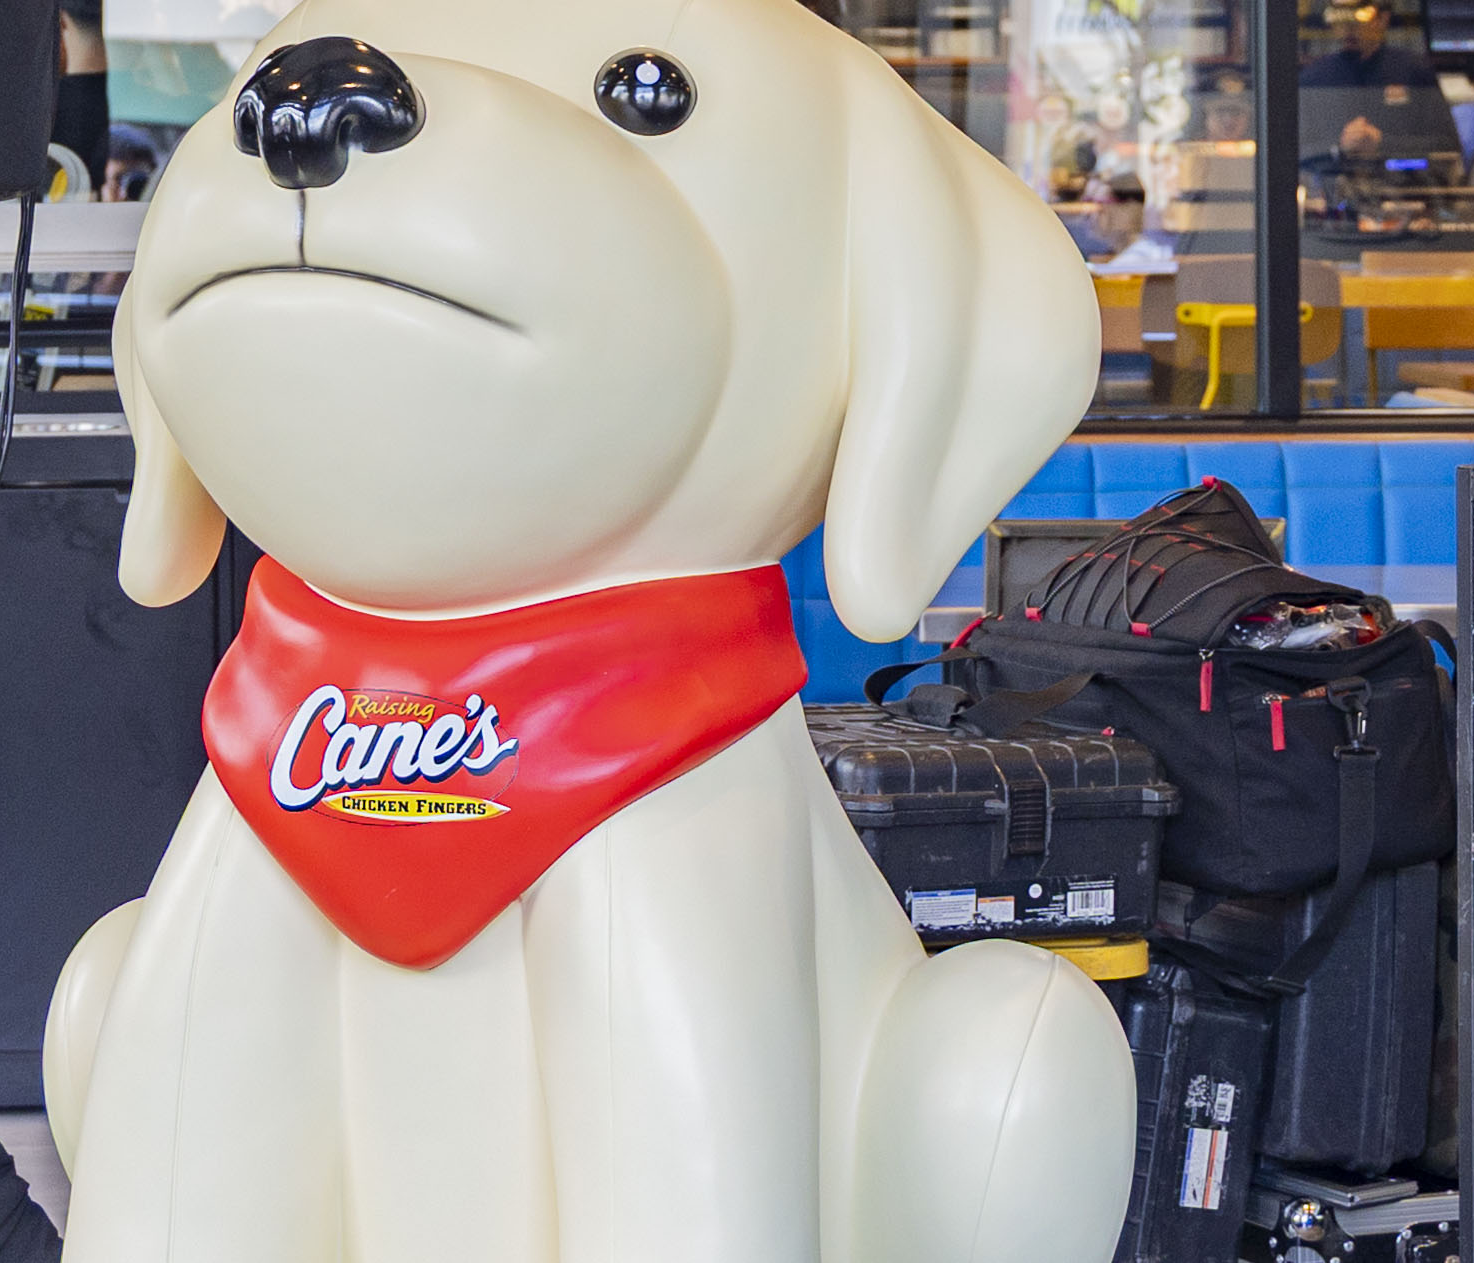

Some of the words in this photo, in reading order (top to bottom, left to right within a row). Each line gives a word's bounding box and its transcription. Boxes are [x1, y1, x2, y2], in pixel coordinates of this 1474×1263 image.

[349, 694, 436, 724] Raising
[270, 684, 519, 810] Cane's
[342, 796, 409, 813] CHICKEN
[416, 798, 487, 815] FINGERS
